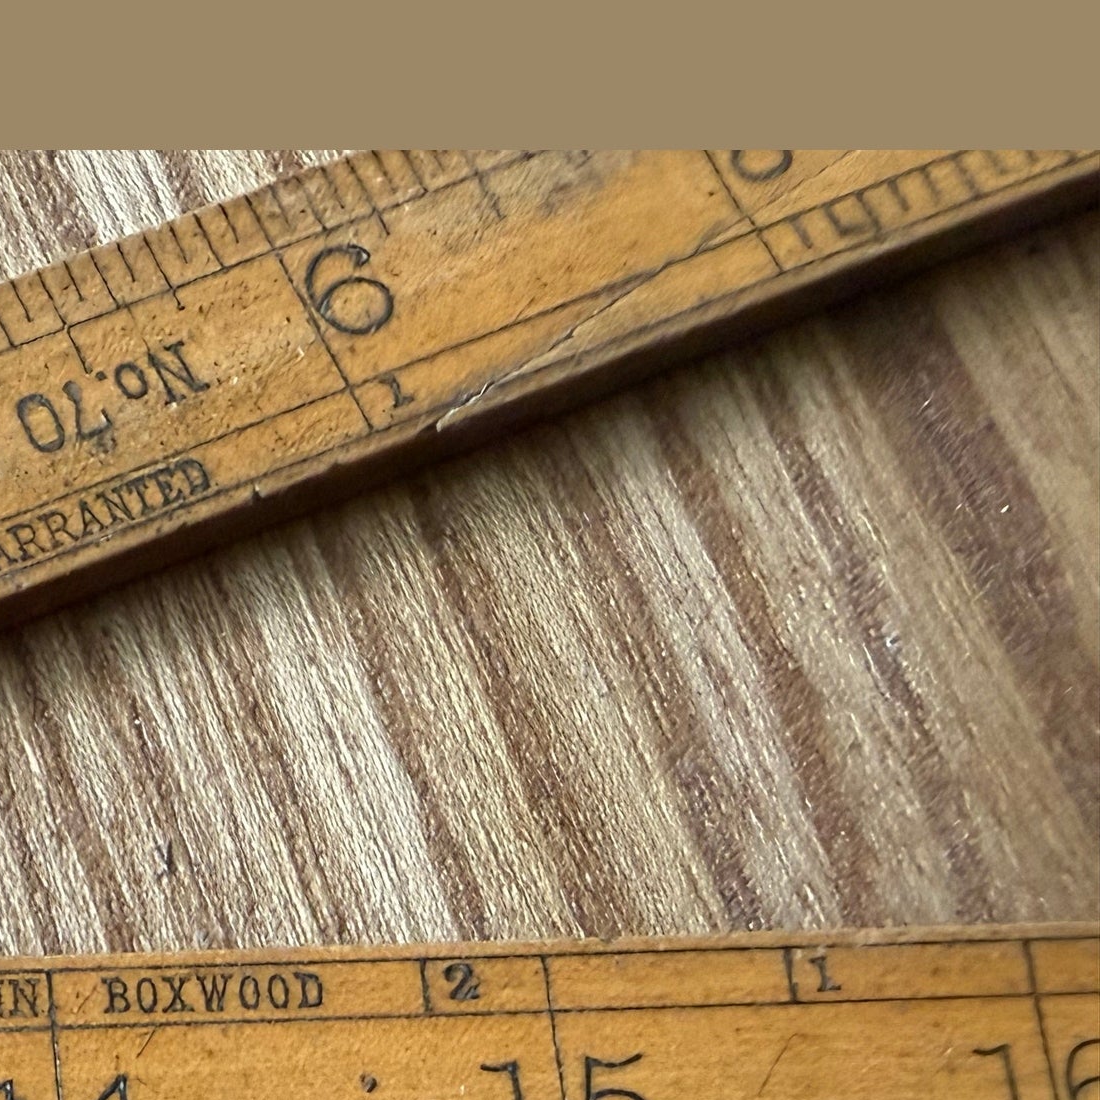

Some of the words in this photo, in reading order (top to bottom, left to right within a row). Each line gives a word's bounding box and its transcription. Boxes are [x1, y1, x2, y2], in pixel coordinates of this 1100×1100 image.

[101, 972, 324, 1014] BOXWOOD
[444, 963, 480, 1000] 2
[810, 955, 842, 993] 1
